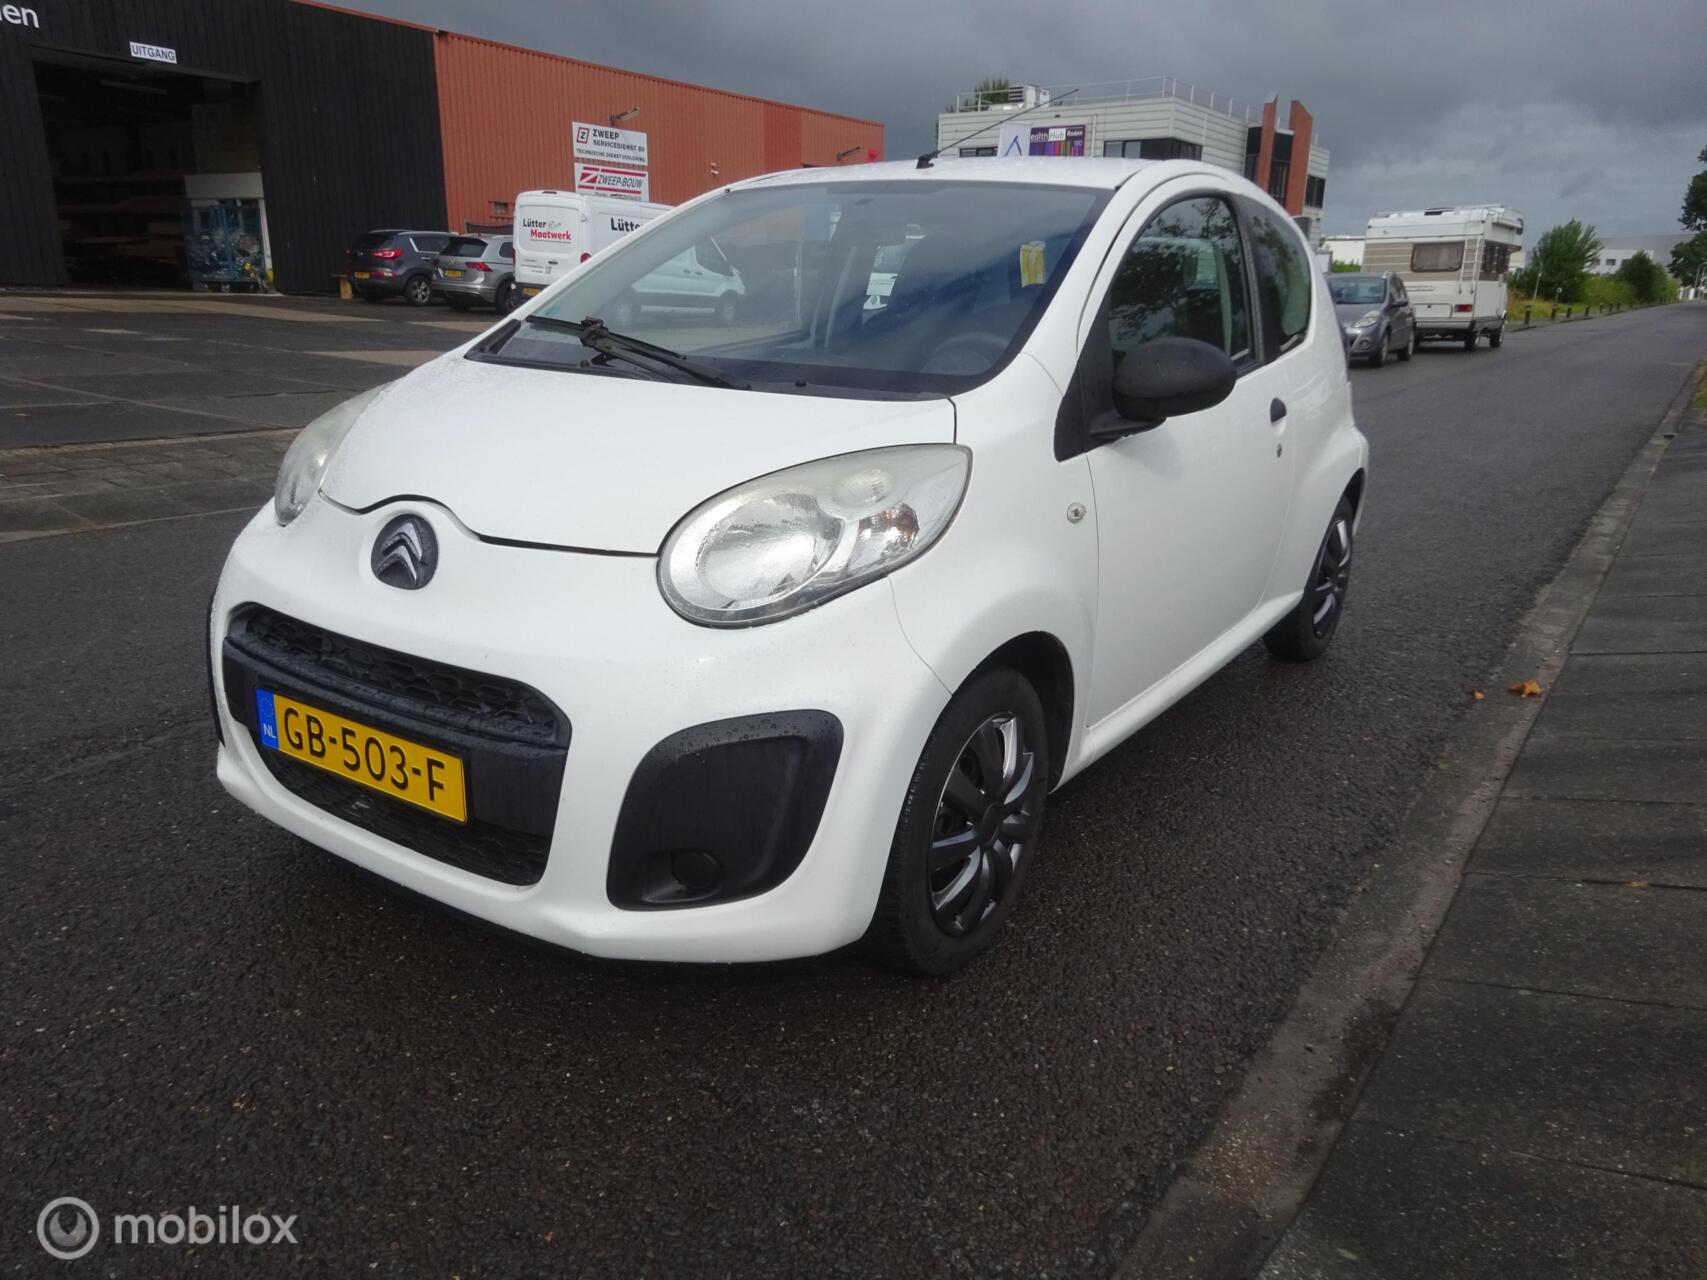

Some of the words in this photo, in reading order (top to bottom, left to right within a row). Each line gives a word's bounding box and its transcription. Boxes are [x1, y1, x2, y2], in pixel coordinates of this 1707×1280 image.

[0, 4, 40, 28] en
[131, 44, 175, 61] UITGANG
[592, 128, 620, 140] ZWEEP
[593, 139, 637, 152] SERVICEDIENST
[576, 148, 606, 157] TECHNISCHE
[523, 218, 546, 228] Lütter
[530, 228, 572, 241] Maatwerk
[263, 722, 277, 740] NL
[283, 706, 446, 802] GB-503-F
